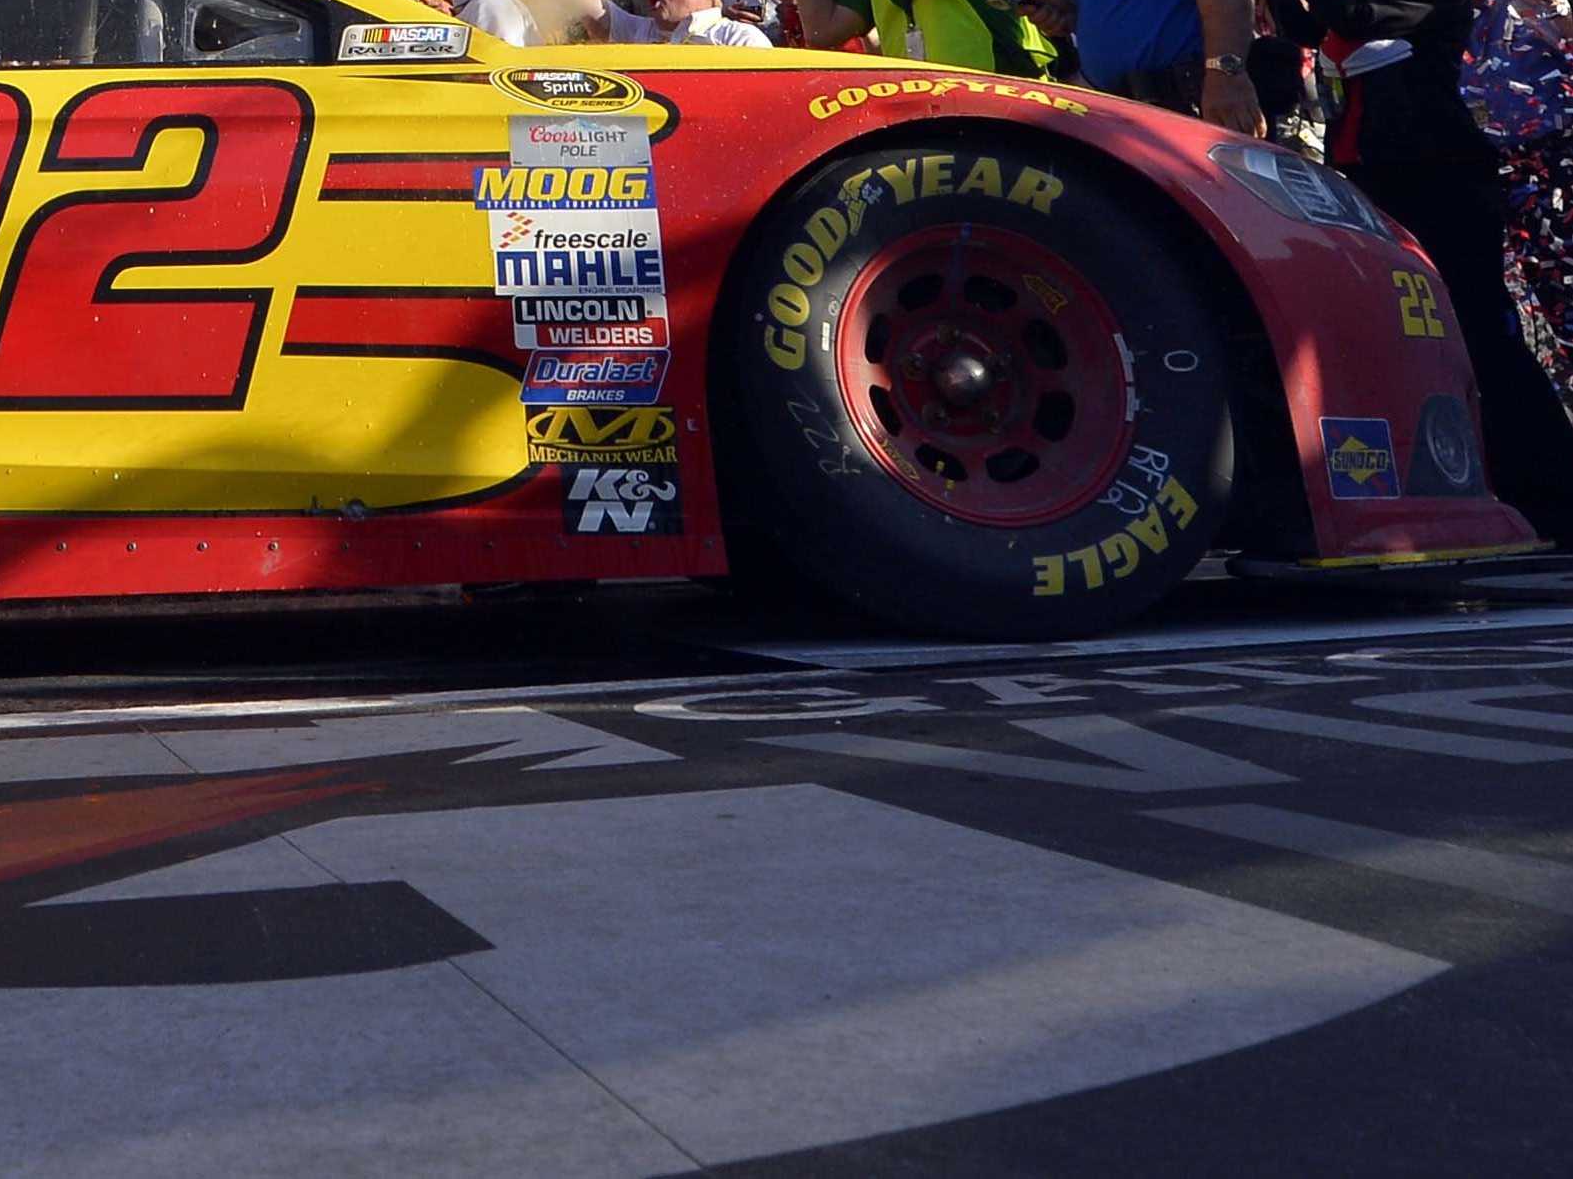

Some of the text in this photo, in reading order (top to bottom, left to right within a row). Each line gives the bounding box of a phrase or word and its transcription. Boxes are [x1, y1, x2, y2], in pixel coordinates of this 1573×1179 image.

[388, 27, 444, 41] NASCAR
[348, 44, 454, 54] RACE CAR
[534, 72, 582, 81] NASCAR
[543, 81, 592, 94] Sprint
[808, 78, 1089, 120] GOODYEAR
[530, 125, 627, 143] Coors LIGHT
[560, 145, 597, 156] POLE
[478, 167, 648, 200] MOOG
[534, 229, 648, 248] freescale
[497, 250, 661, 286] MAHLE
[764, 154, 1065, 371] GOODYEAR
[521, 300, 639, 322] LINCOLN
[1392, 270, 1445, 338] 22
[549, 327, 653, 345] WELDERS
[533, 357, 657, 382] Duralast
[566, 389, 625, 401] BRAKES
[529, 445, 677, 463] MECHANIX WEAR
[1331, 450, 1388, 470] SUNOCO
[1033, 475, 1199, 597] EAGLE
